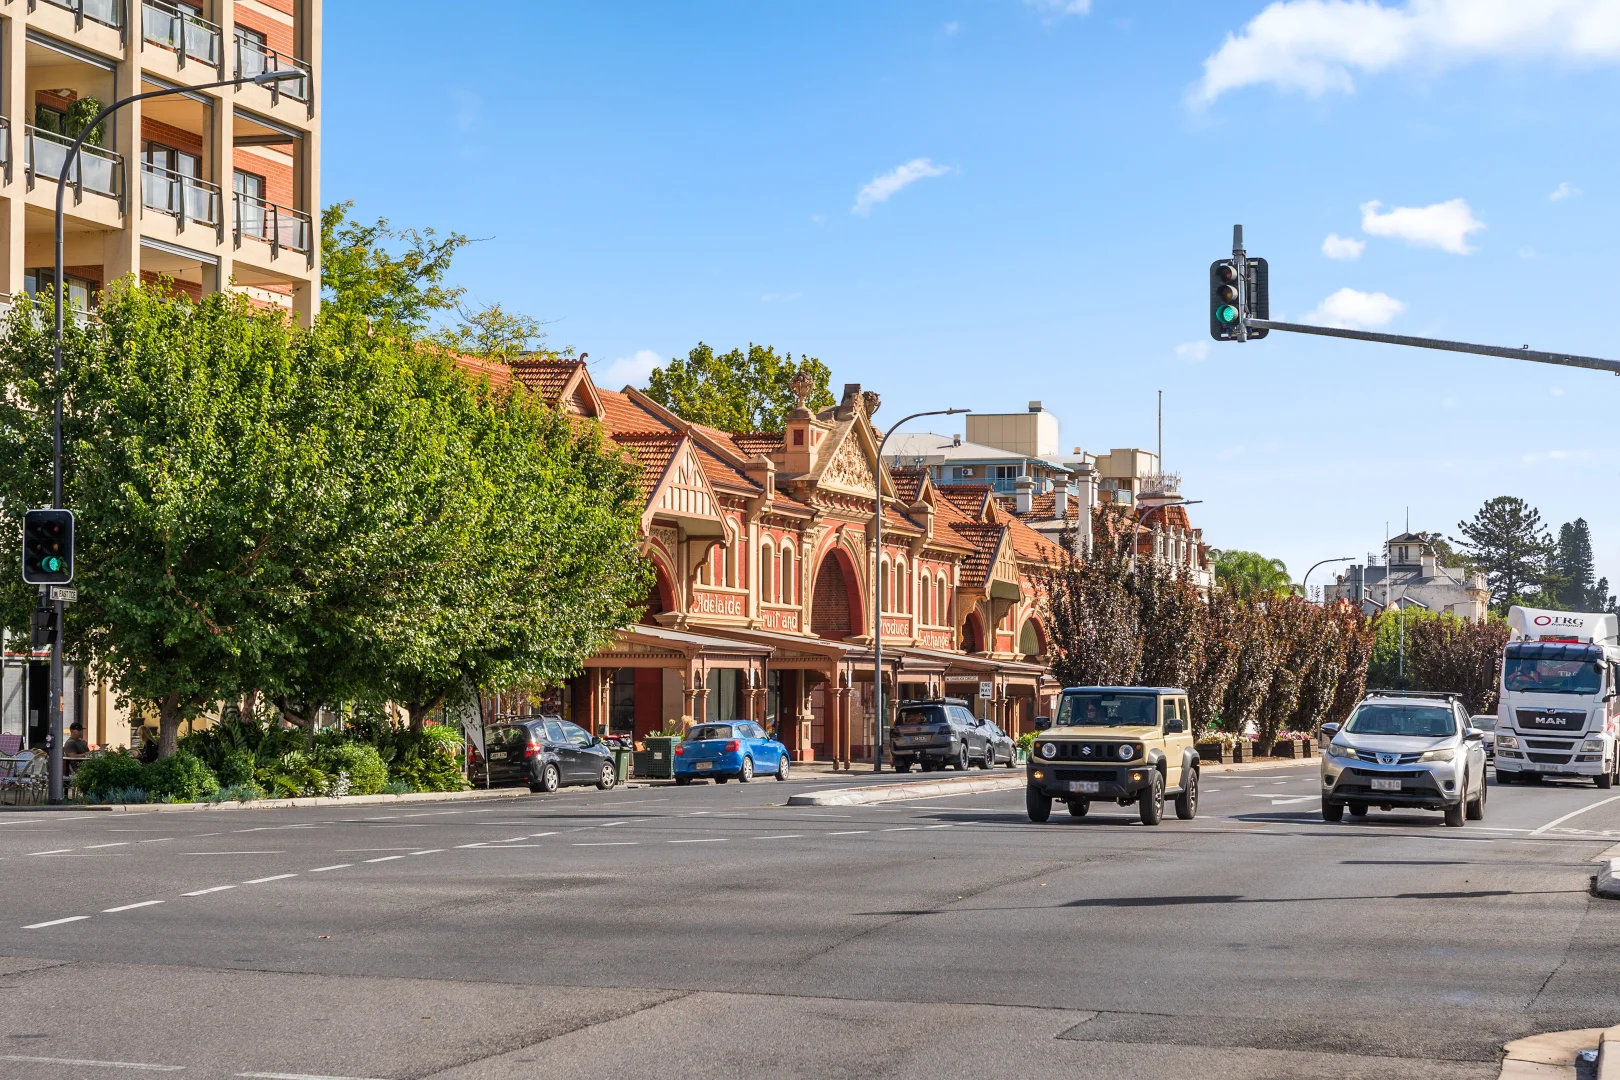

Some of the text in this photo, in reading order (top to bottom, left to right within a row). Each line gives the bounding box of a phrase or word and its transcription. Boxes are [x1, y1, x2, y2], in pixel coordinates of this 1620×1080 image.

[59, 590, 69, 598] EAST
[694, 593, 741, 615] Adelaide
[782, 612, 798, 632] and
[1552, 616, 1584, 625] TRG
[918, 630, 949, 650] Exchange
